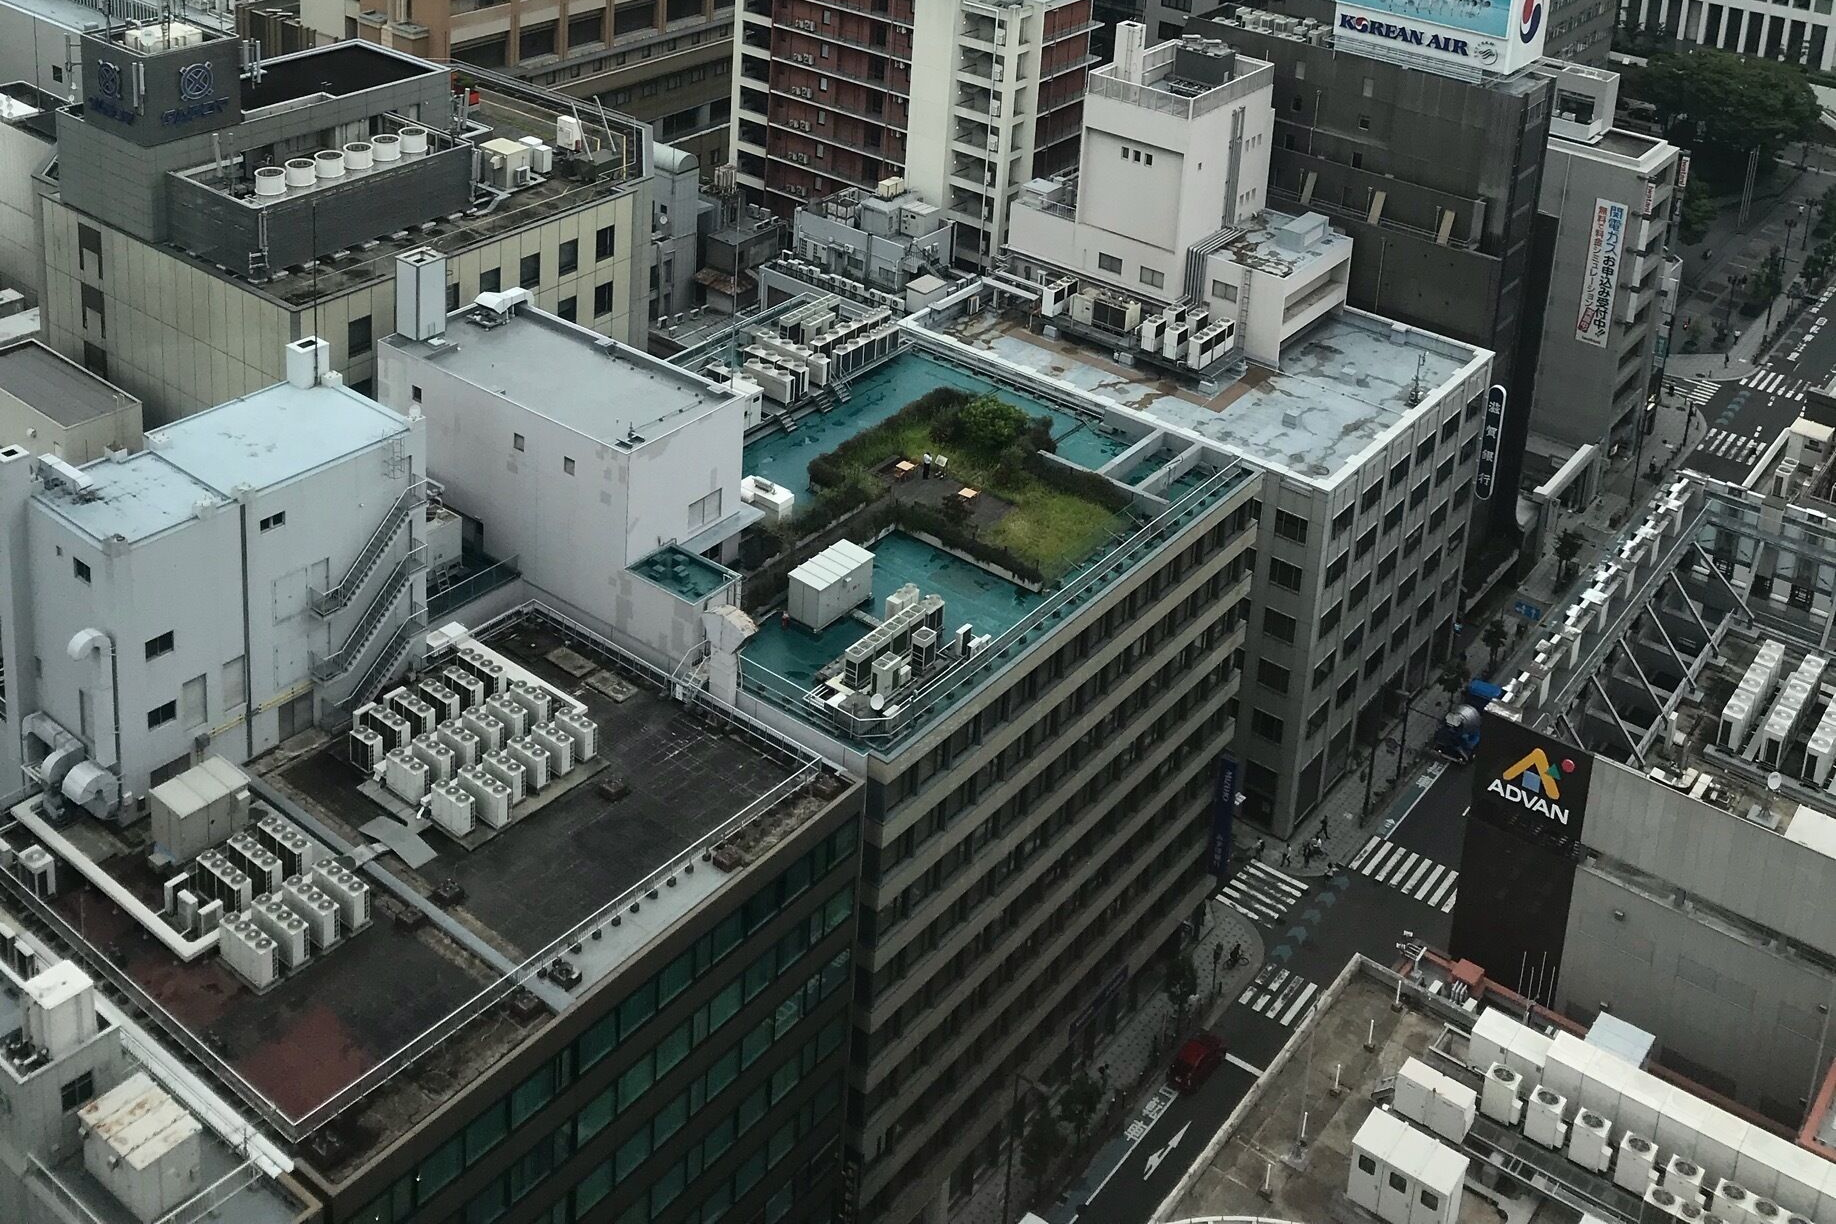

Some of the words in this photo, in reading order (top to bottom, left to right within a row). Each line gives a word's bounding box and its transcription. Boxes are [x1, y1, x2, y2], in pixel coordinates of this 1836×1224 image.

[1339, 13, 1425, 46] KOREAN
[1427, 34, 1469, 56] AIR
[1478, 401, 1502, 486] 滋賀銀行
[1487, 778, 1570, 825] ADVAN
